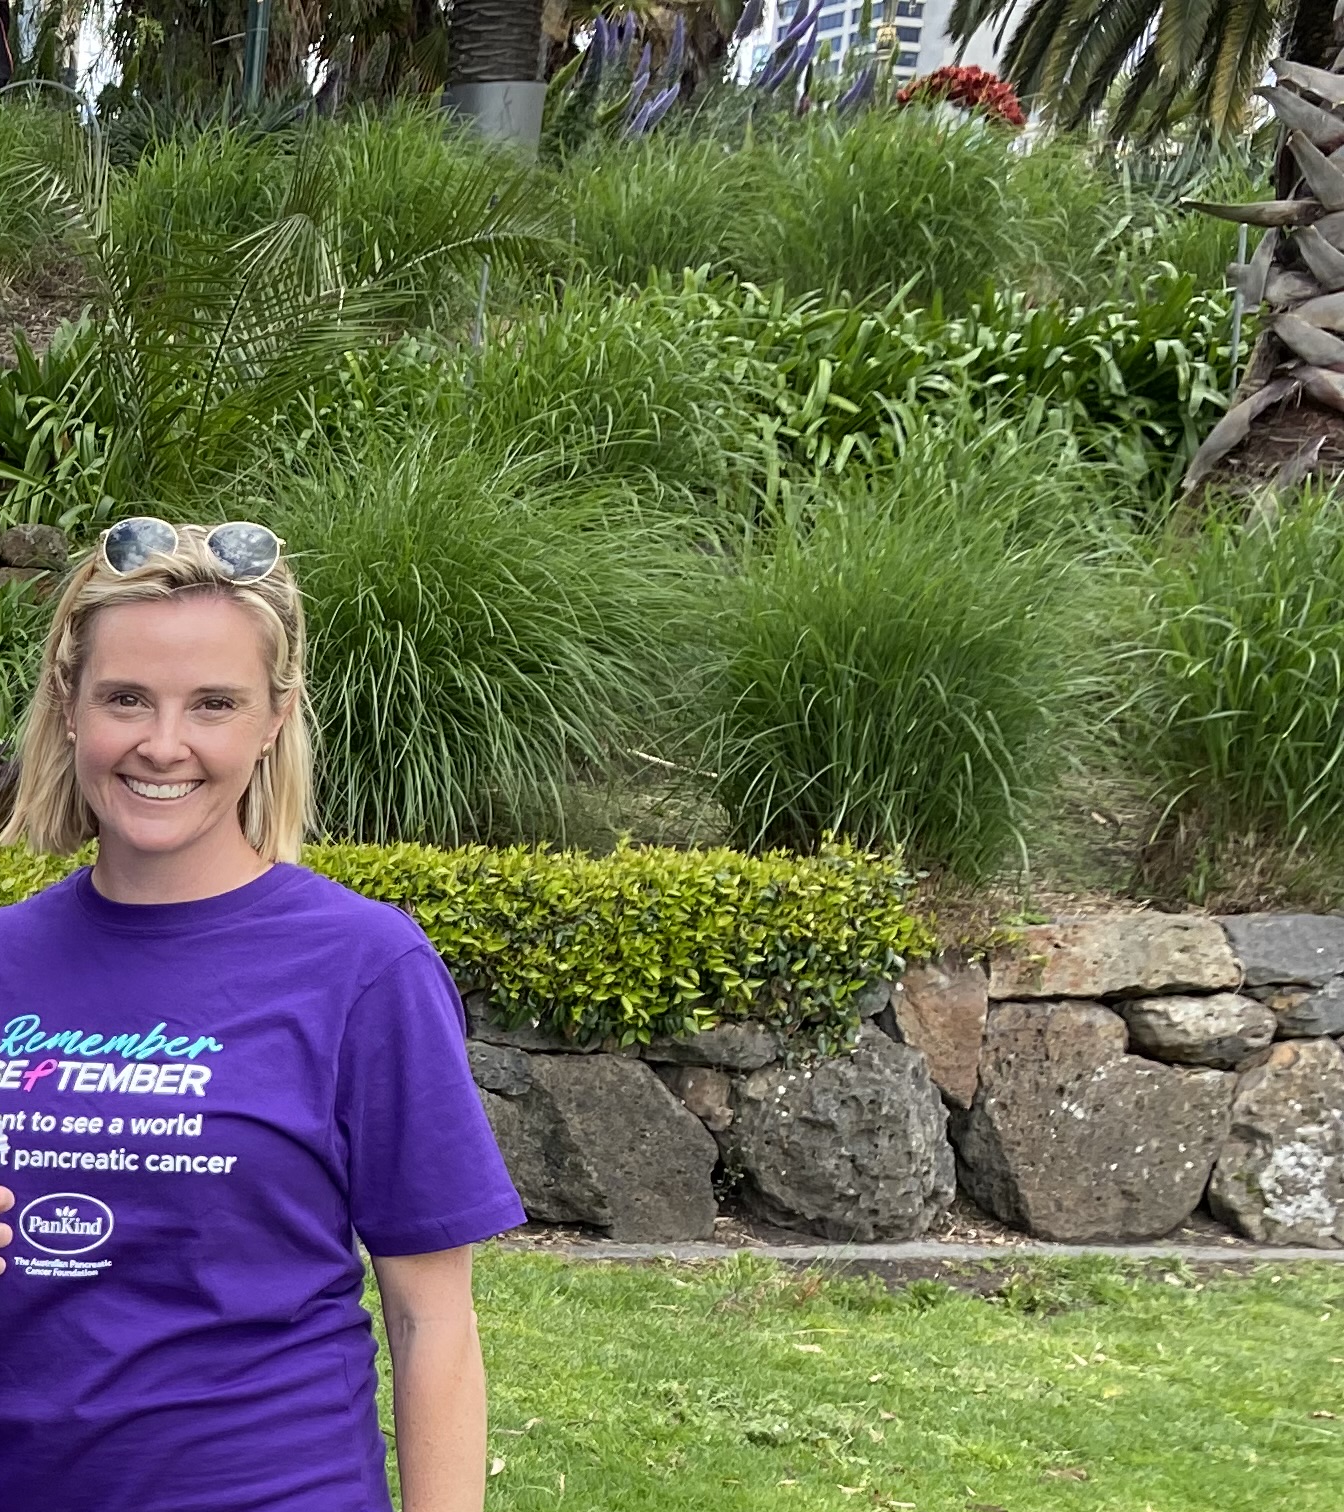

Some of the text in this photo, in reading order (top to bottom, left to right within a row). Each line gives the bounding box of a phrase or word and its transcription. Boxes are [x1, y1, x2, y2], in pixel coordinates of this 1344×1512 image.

[31, 1111, 56, 1132] to
[61, 1115, 102, 1134] see
[108, 1116, 123, 1134] a
[130, 1113, 204, 1137] world
[14, 1148, 139, 1171] pancreatic
[145, 1154, 238, 1174] cancer
[28, 1215, 103, 1236] PanKind
[14, 1256, 30, 1266] The
[25, 1266, 99, 1277] Cancer Foundation
